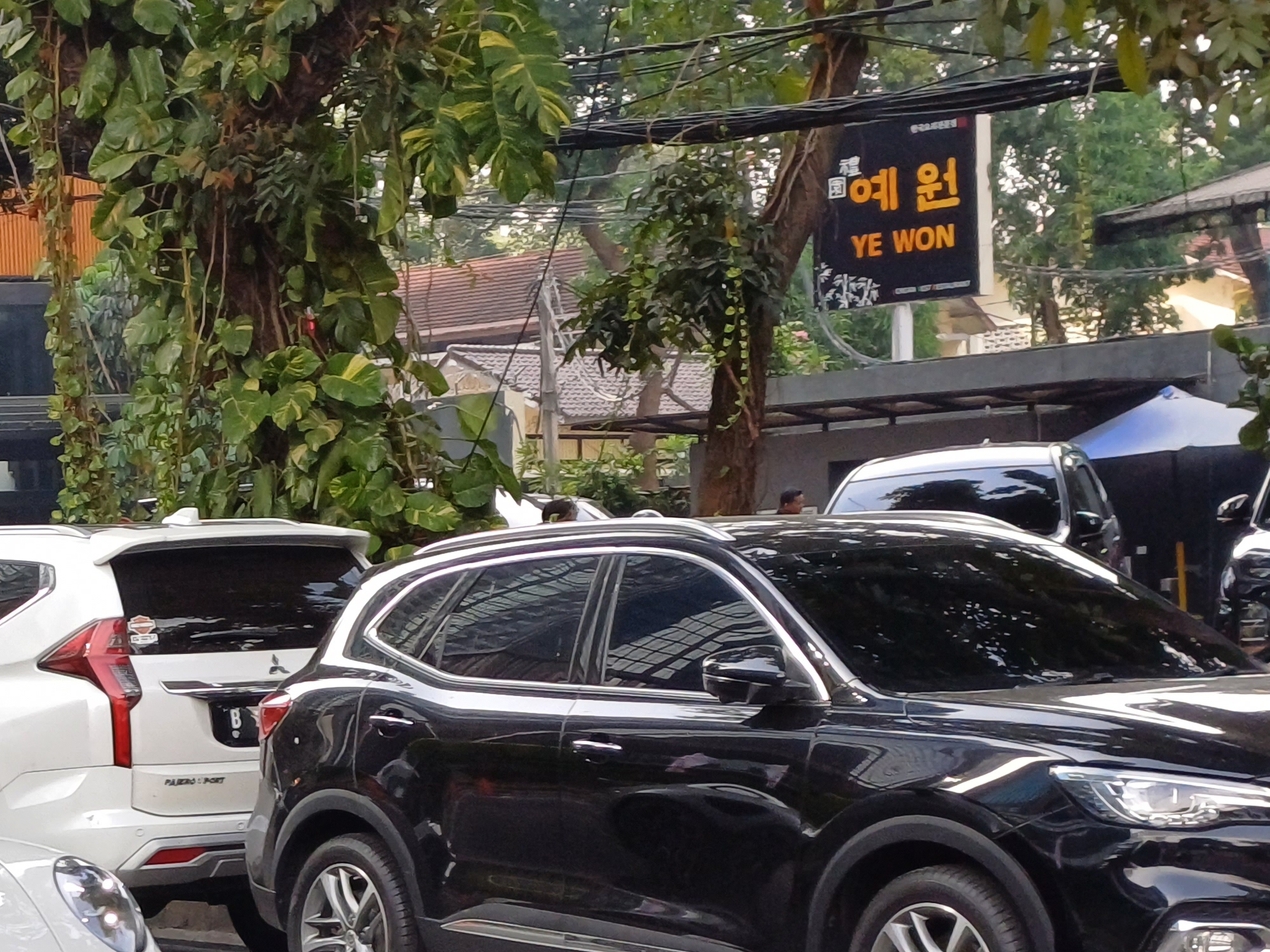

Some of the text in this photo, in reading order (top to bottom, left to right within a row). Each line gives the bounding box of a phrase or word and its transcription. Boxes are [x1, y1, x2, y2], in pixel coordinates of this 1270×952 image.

[851, 223, 955, 259] YE WON
[230, 707, 242, 729] B
